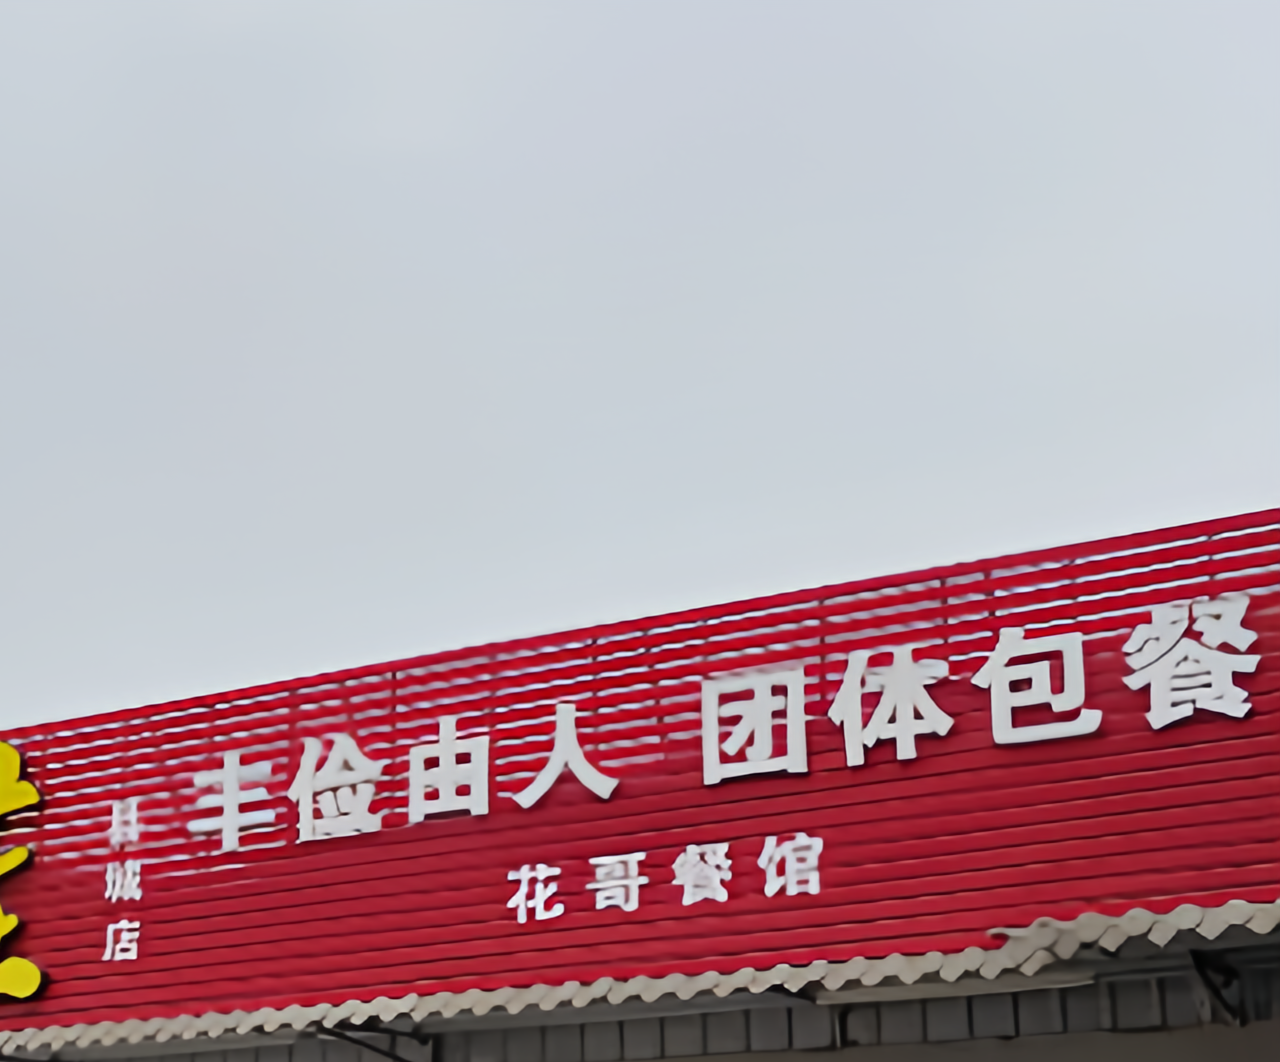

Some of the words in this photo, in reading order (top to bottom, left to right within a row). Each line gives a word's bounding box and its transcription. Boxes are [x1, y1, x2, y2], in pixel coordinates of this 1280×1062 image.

[186, 702, 620, 853] 丰俭由人
[700, 592, 1262, 786] 团体包餐
[506, 832, 825, 925] 花哥餐馆
